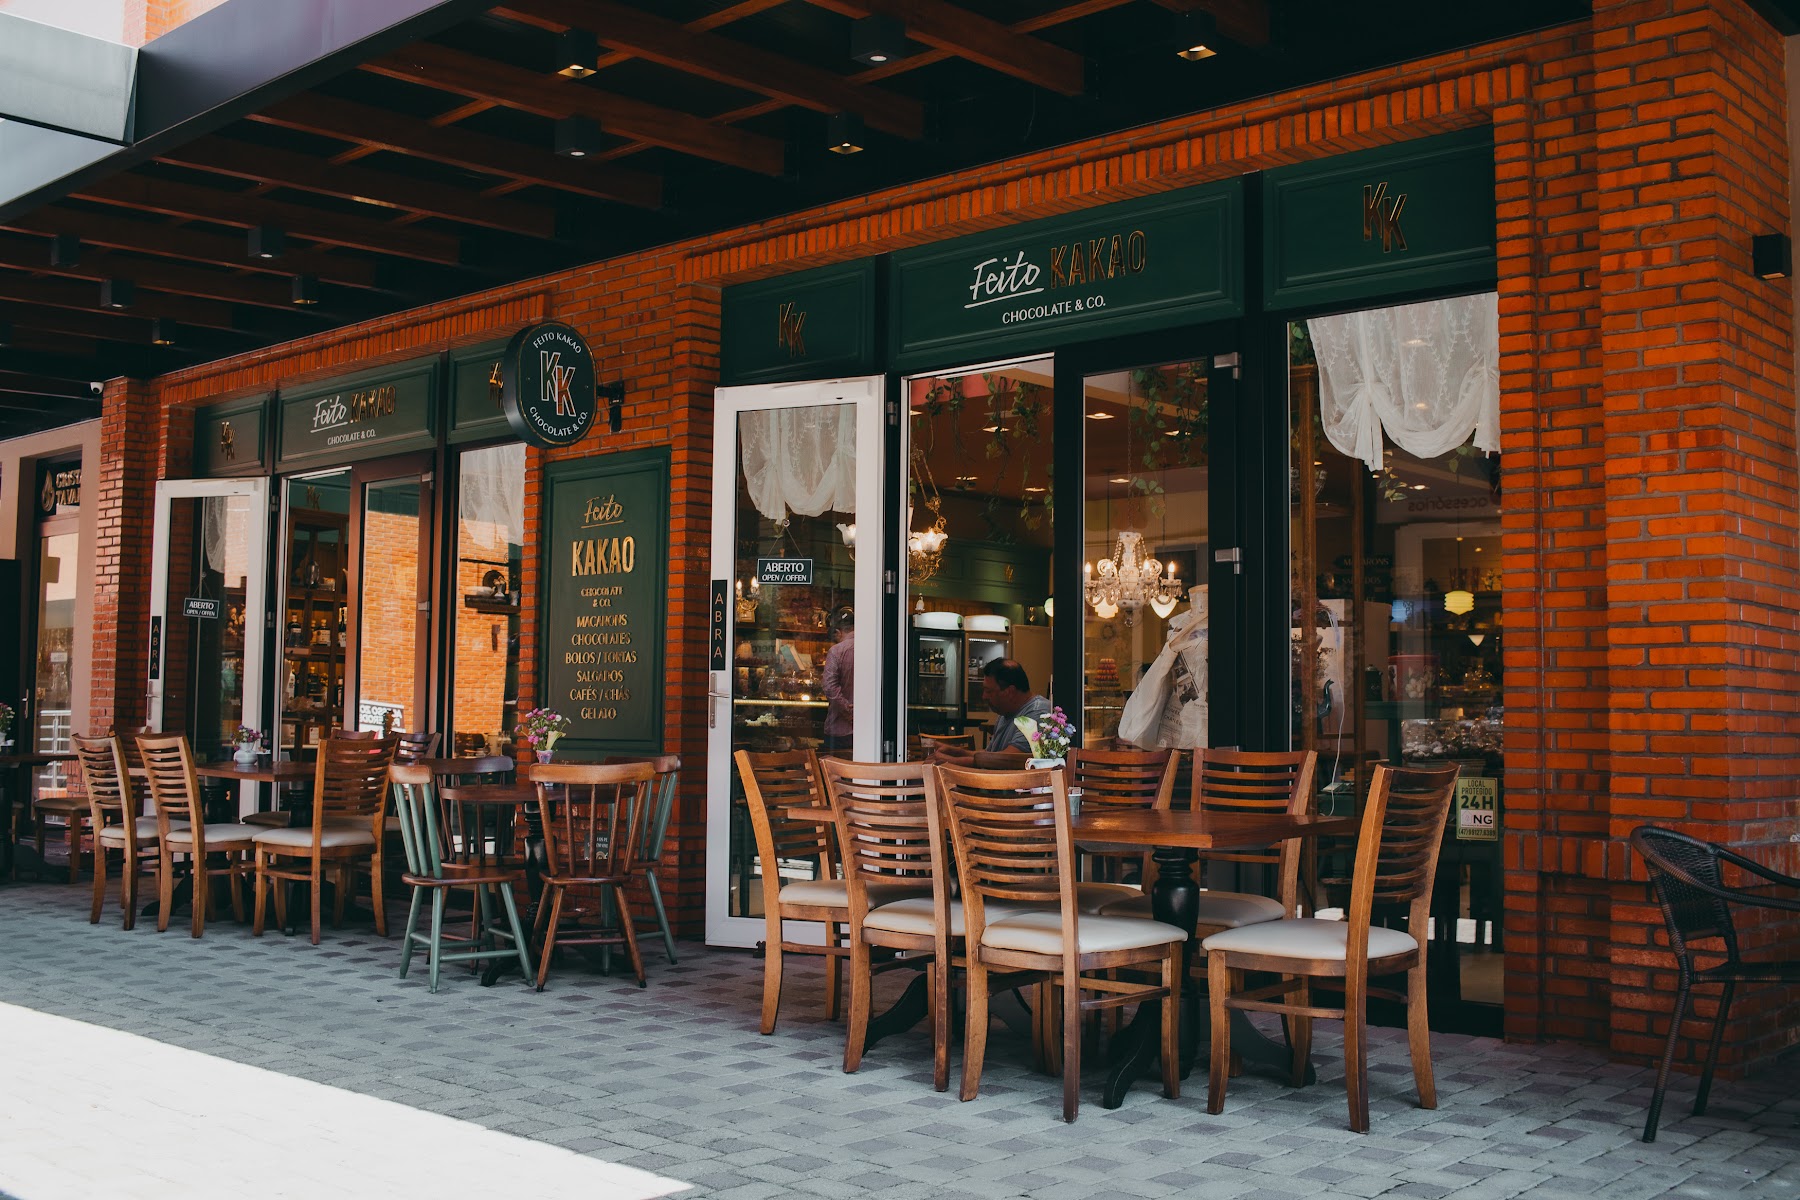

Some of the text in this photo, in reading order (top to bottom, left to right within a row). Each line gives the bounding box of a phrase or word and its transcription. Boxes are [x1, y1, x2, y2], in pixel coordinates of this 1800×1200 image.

[1363, 182, 1407, 253] KK
[969, 230, 1146, 301] Feito KAKAO
[1002, 295, 1106, 324] CHOCOLATE & CO.
[779, 302, 806, 358] KK
[532, 332, 582, 354] FEITO KAKAO
[540, 350, 577, 417] KK
[312, 385, 396, 428] Feito KAKAO
[529, 406, 588, 437] CHOCOLATE & CO.
[327, 431, 360, 446] CHOCOLATE
[583, 494, 624, 524] Feito
[571, 536, 635, 577] KAKAO
[764, 562, 804, 573] ABERTO
[761, 574, 780, 582] OPEN
[785, 574, 807, 582] OFFEN
[580, 586, 624, 597] CHOCOLATE
[188, 601, 214, 610] ABERTO
[592, 598, 598, 608] &
[576, 614, 628, 628] MACARONS
[713, 592, 724, 658] ABRA
[571, 632, 631, 646] CHOCOLATES
[151, 624, 159, 671] ABRA
[565, 651, 596, 664] BOLOS
[602, 650, 637, 663] TORTAS
[576, 669, 624, 683] SALGADOS
[569, 685, 598, 701] CAFÉS
[604, 685, 632, 701] CHÁS
[580, 707, 617, 719] GELATO
[1473, 814, 1493, 825] NG
